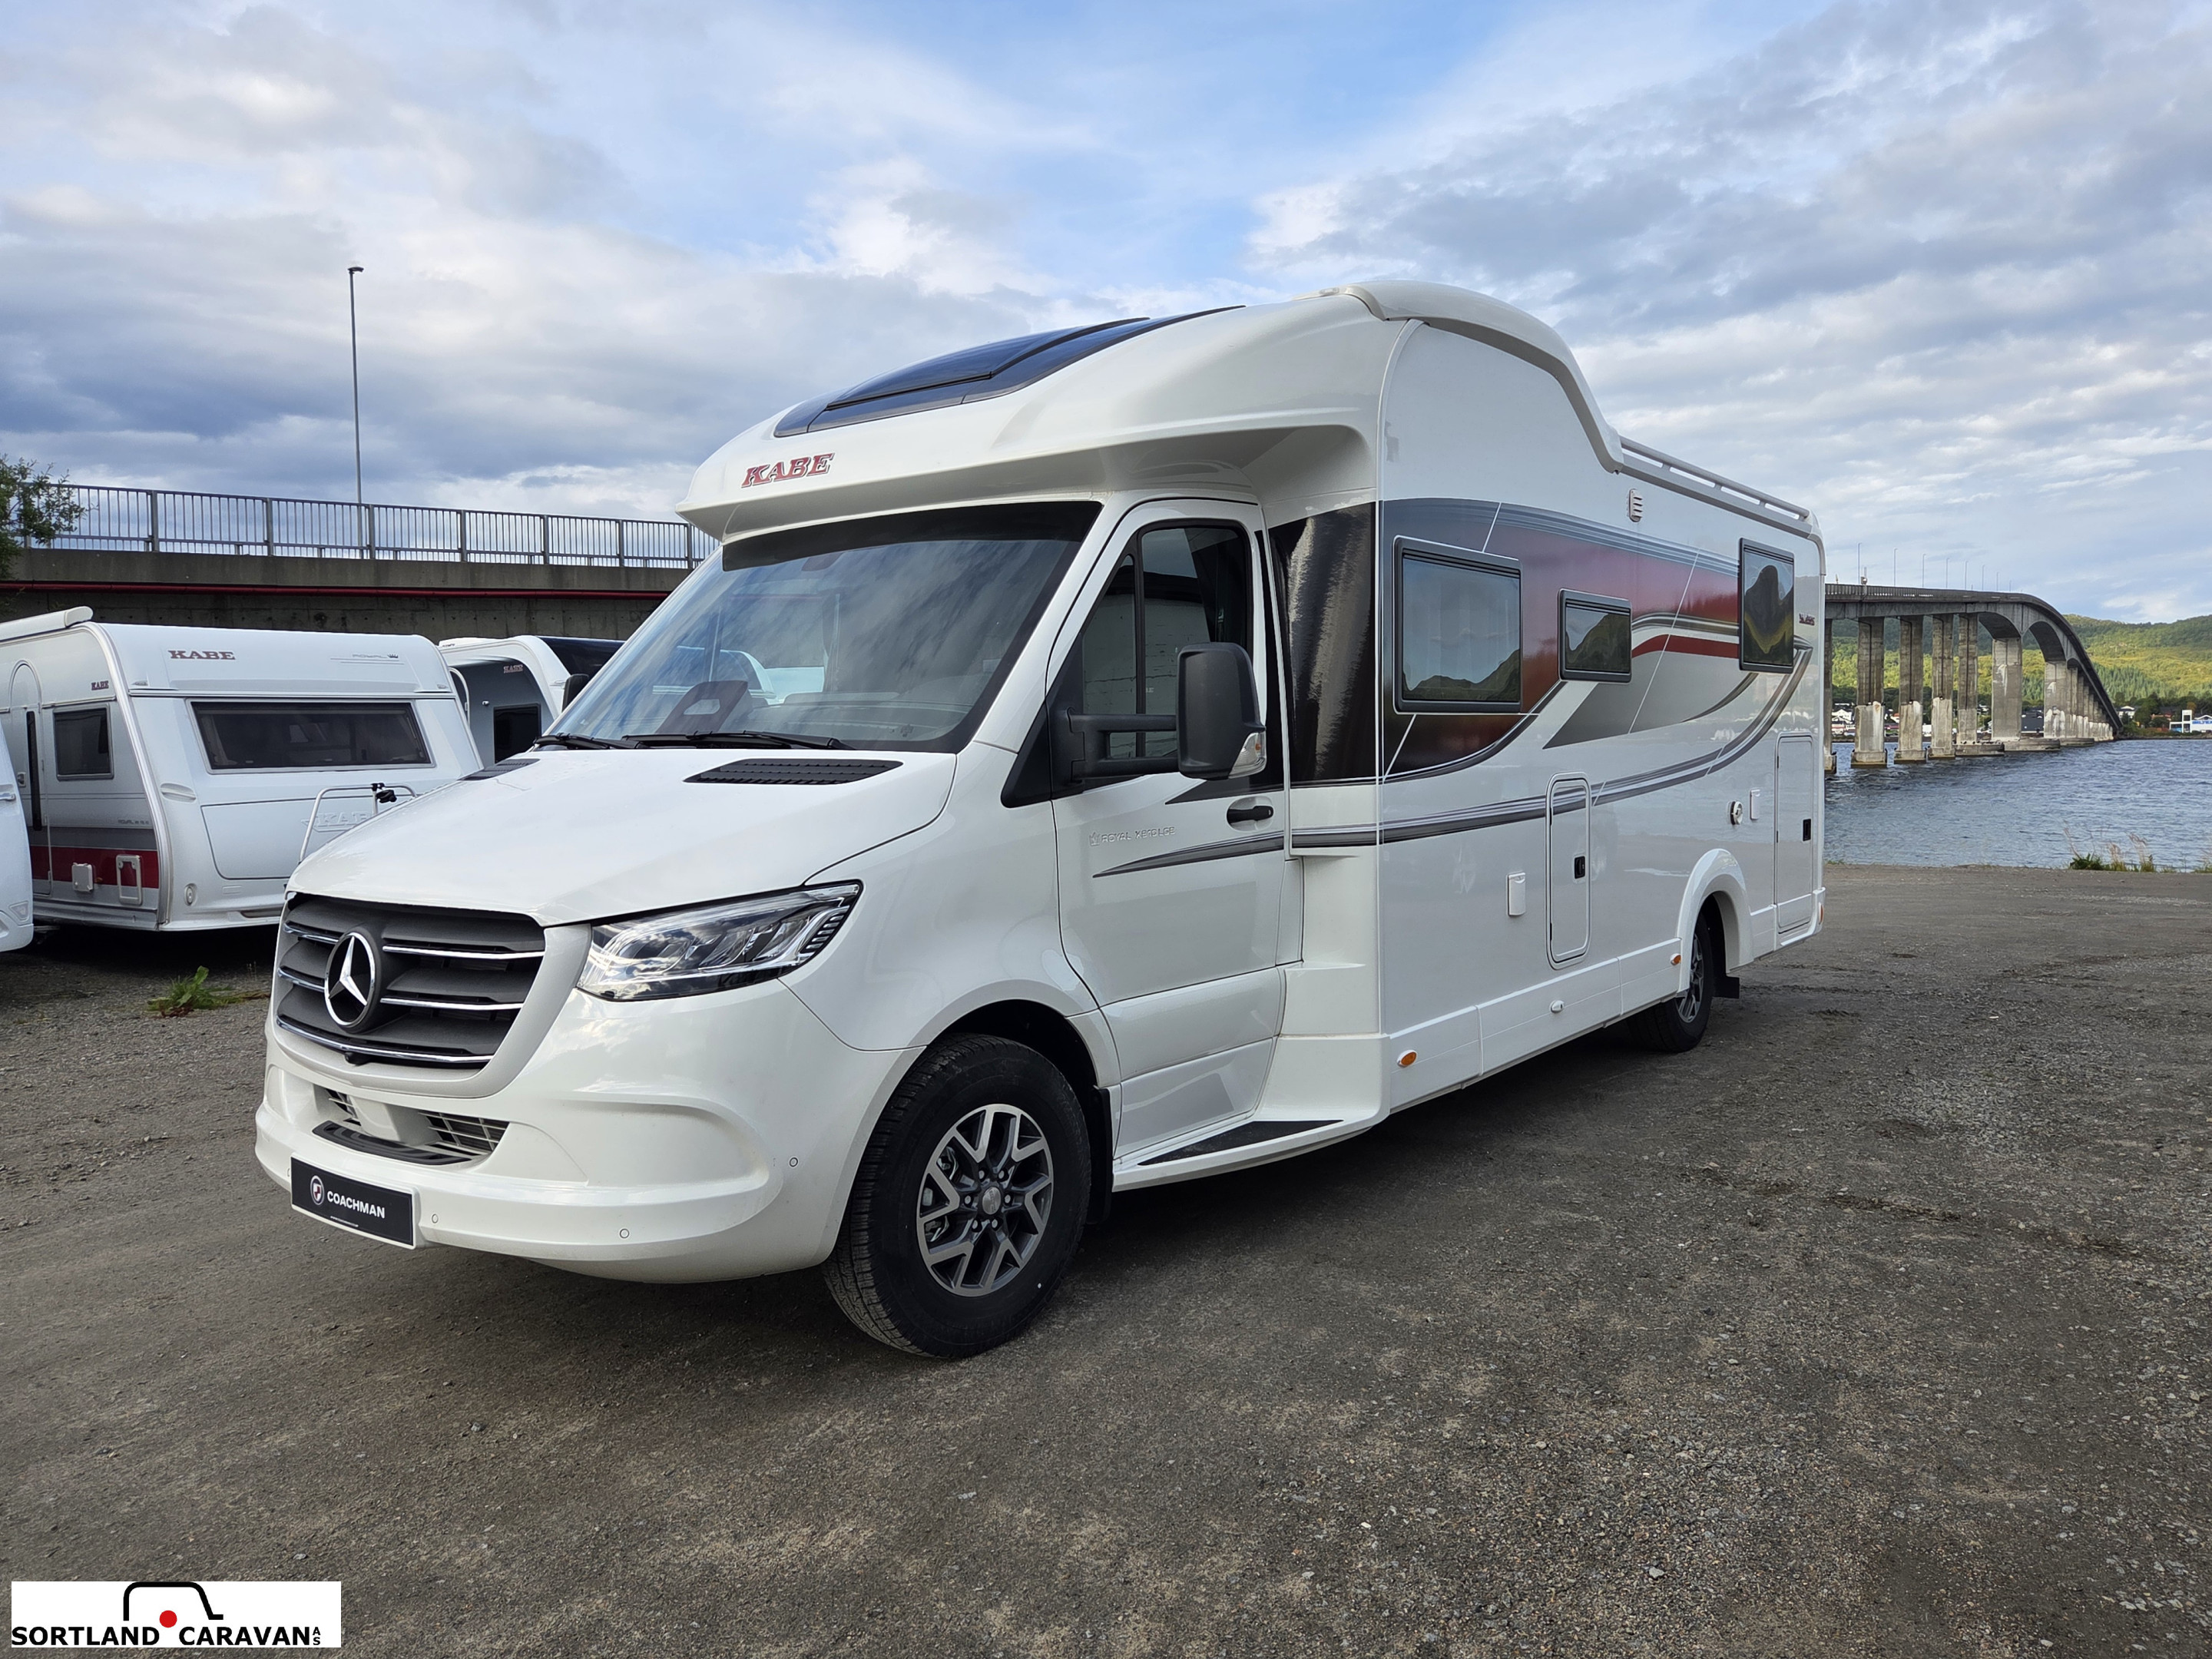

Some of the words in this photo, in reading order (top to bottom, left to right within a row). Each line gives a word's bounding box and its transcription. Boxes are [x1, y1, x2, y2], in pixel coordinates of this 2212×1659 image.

[740, 452, 836, 488] KABE
[167, 650, 236, 661] KABE
[1101, 832, 1132, 844] ROYAL
[326, 1190, 386, 1219] COACHMAN
